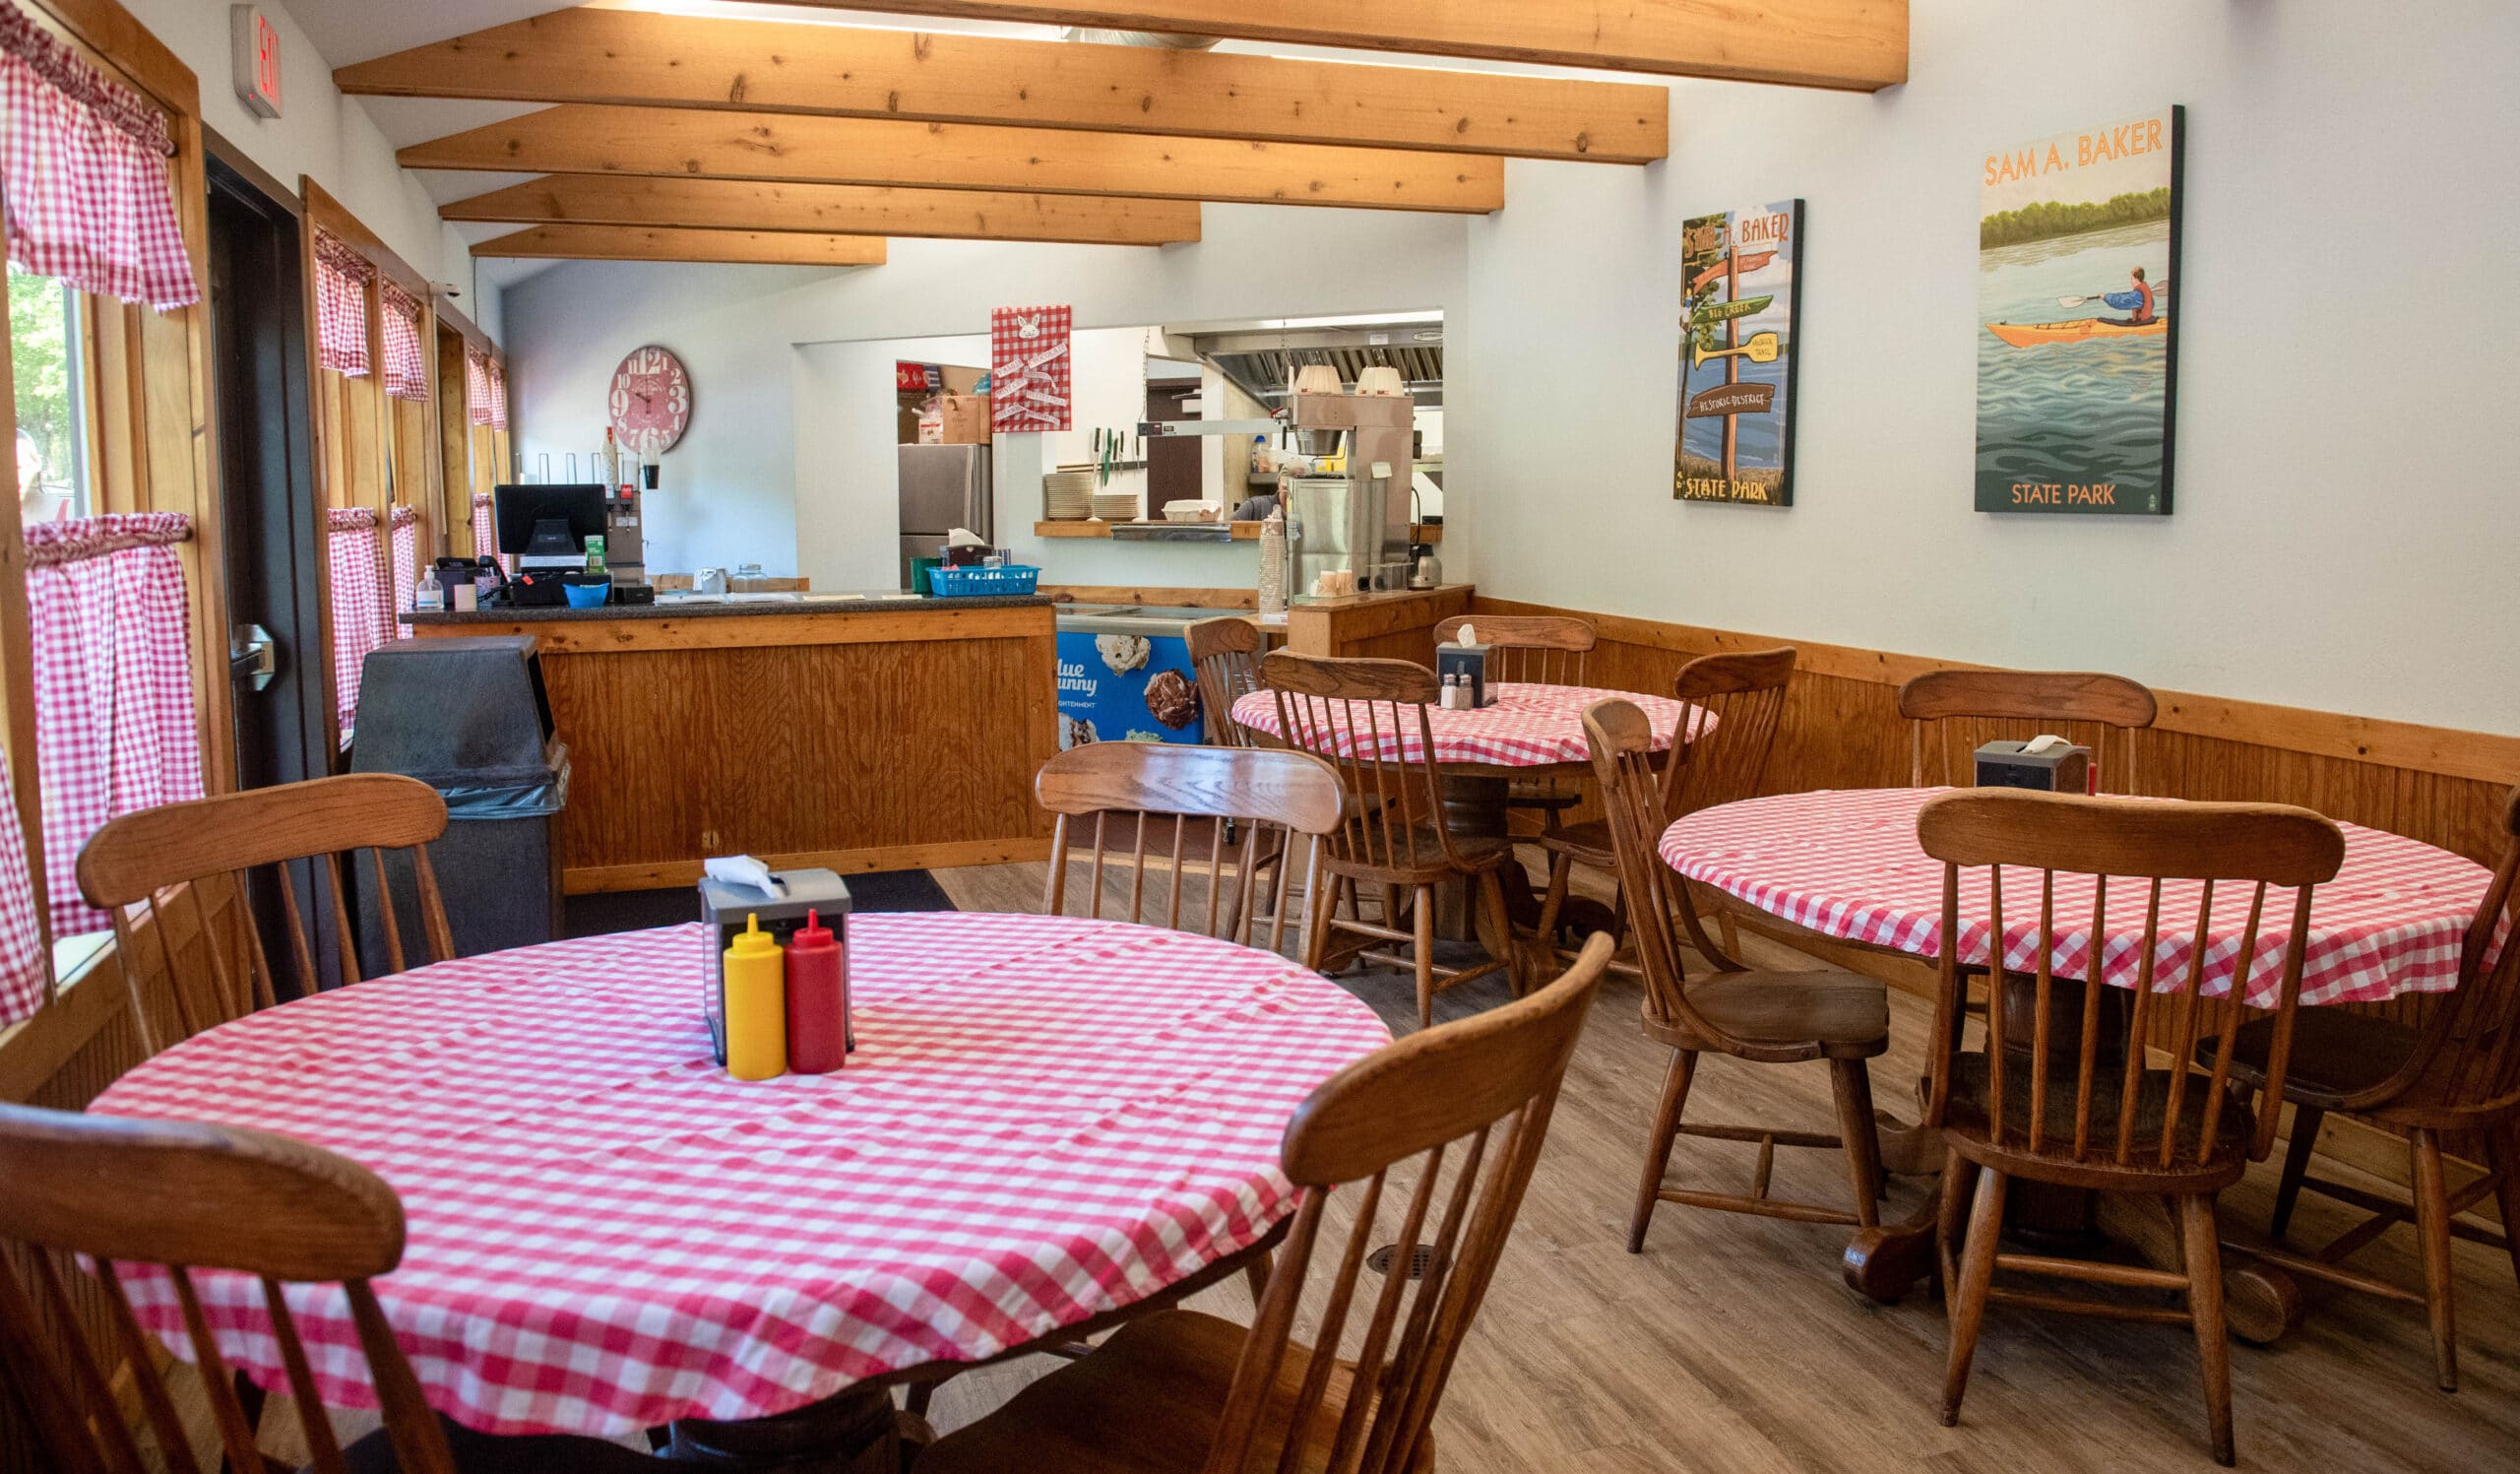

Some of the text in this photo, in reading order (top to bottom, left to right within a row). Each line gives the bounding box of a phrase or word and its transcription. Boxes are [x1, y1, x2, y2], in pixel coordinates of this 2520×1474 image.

[1984, 119, 2164, 186] SAM A. BAKER
[1741, 212, 1790, 243] BAKER
[628, 359, 639, 375] 11
[639, 348, 662, 375] 12
[662, 357, 668, 371] 1
[617, 374, 631, 388] 10
[670, 368, 681, 384] 2
[611, 389, 629, 417] 9
[668, 386, 686, 414] 3
[1699, 394, 1765, 412] HISTORIC DISTRICT
[617, 417, 628, 432] 8
[630, 429, 639, 446] 7
[639, 427, 660, 454] 6
[661, 429, 670, 445] 5
[1685, 478, 1768, 500] STATE PARK
[2012, 483, 2115, 505] STATE PARK
[1057, 658, 1085, 677] lue
[1057, 677, 1098, 697] unny
